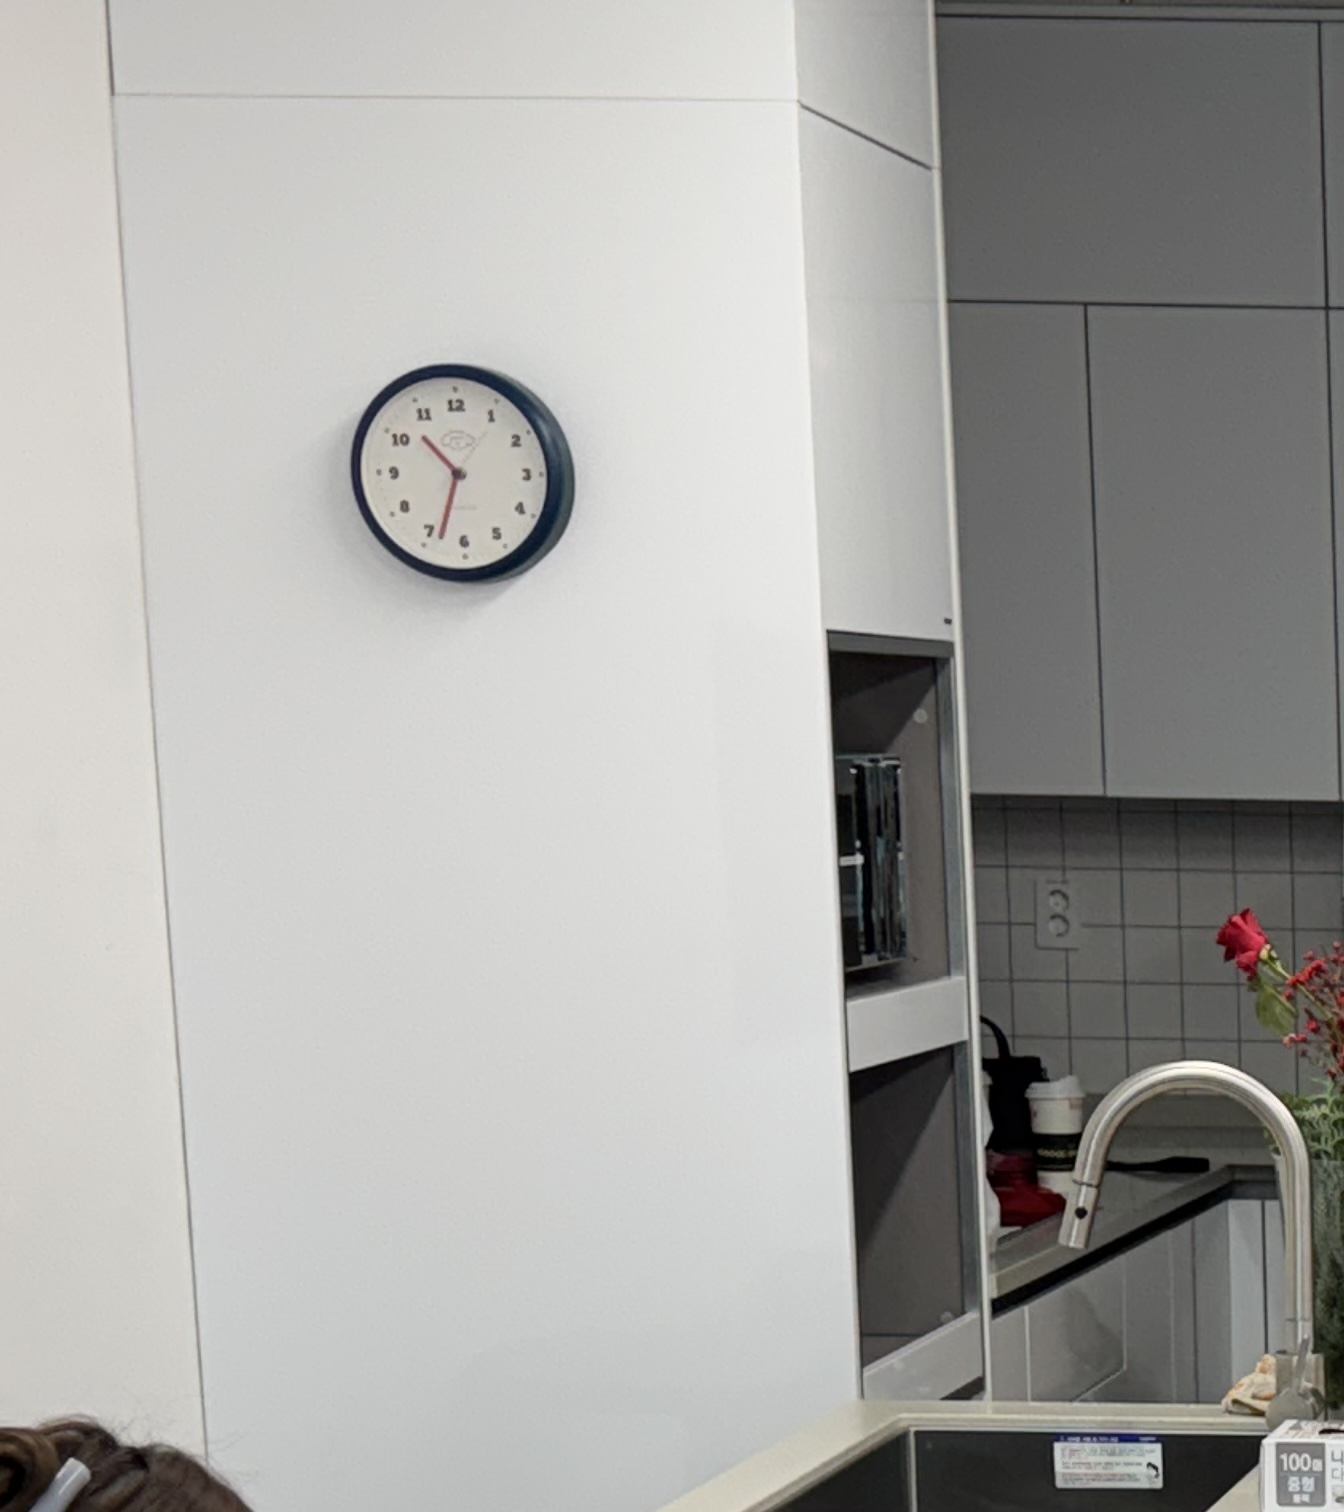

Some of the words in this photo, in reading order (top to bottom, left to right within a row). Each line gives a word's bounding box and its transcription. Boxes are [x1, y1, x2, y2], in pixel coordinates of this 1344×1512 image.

[447, 399, 465, 412] 12
[416, 408, 432, 421] 11
[487, 410, 496, 422] 1
[391, 433, 410, 446] 10
[511, 435, 522, 447] 2
[389, 467, 399, 480] 9
[522, 468, 532, 481] 3
[400, 500, 410, 513] 8
[515, 502, 526, 514] 4
[424, 525, 435, 537] 7
[492, 528, 502, 540] 5
[459, 536, 470, 548] 6
